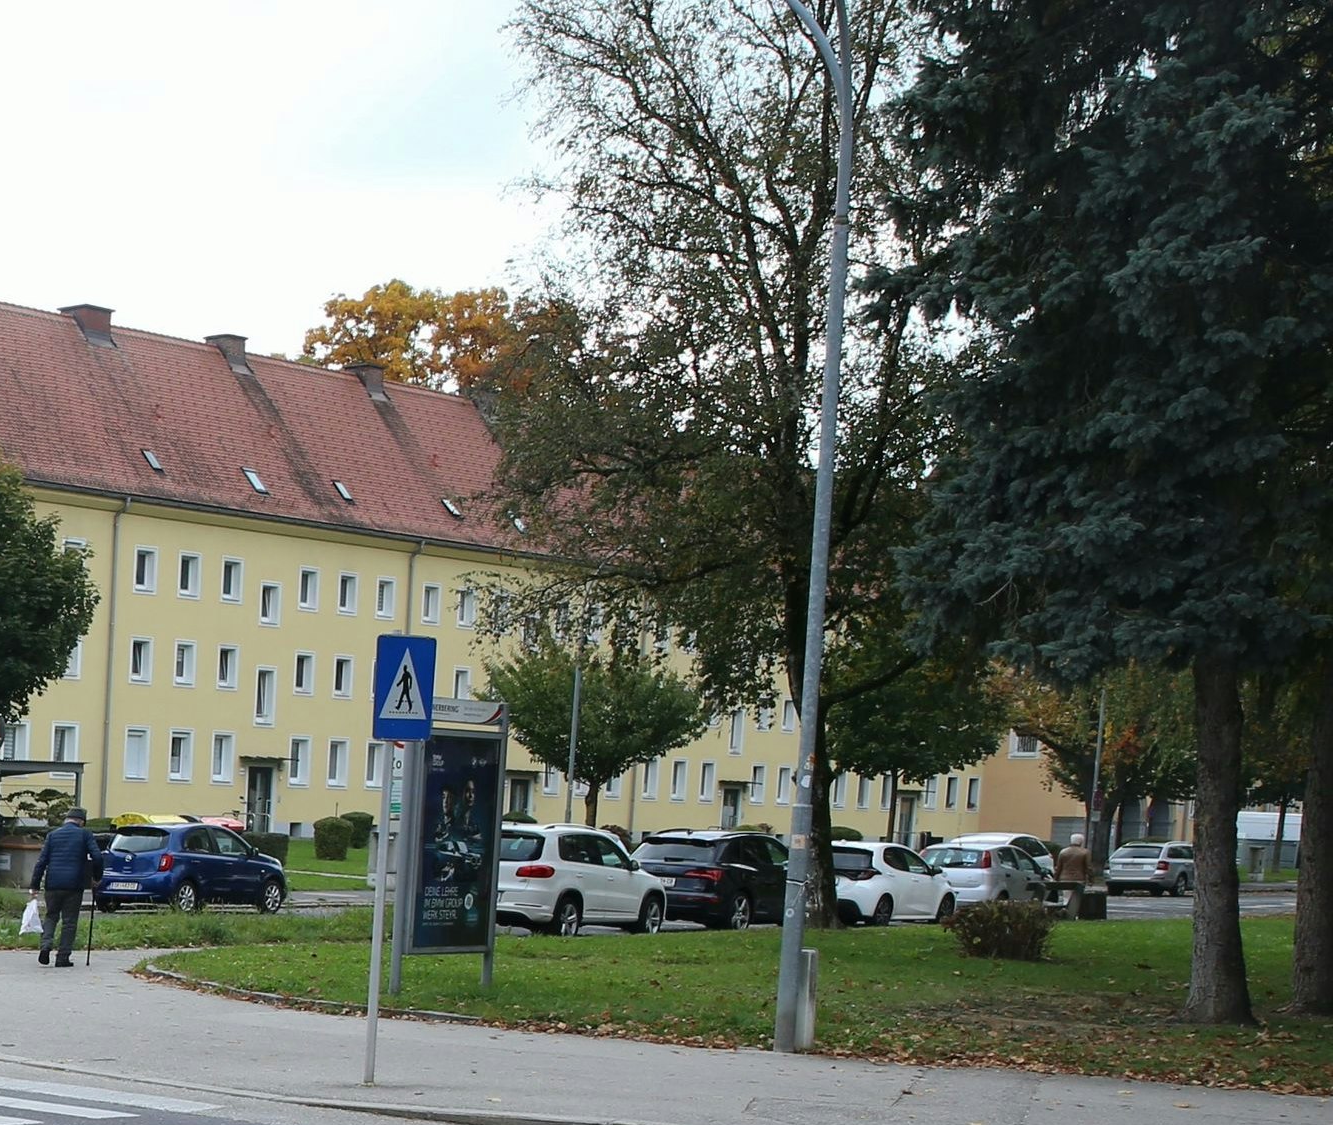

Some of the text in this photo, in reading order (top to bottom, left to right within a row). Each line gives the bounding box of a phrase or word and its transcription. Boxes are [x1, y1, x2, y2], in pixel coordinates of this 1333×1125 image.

[424, 886, 459, 897] DEINE LEHRE
[431, 898, 444, 908] BMW
[444, 898, 464, 908] GROUP
